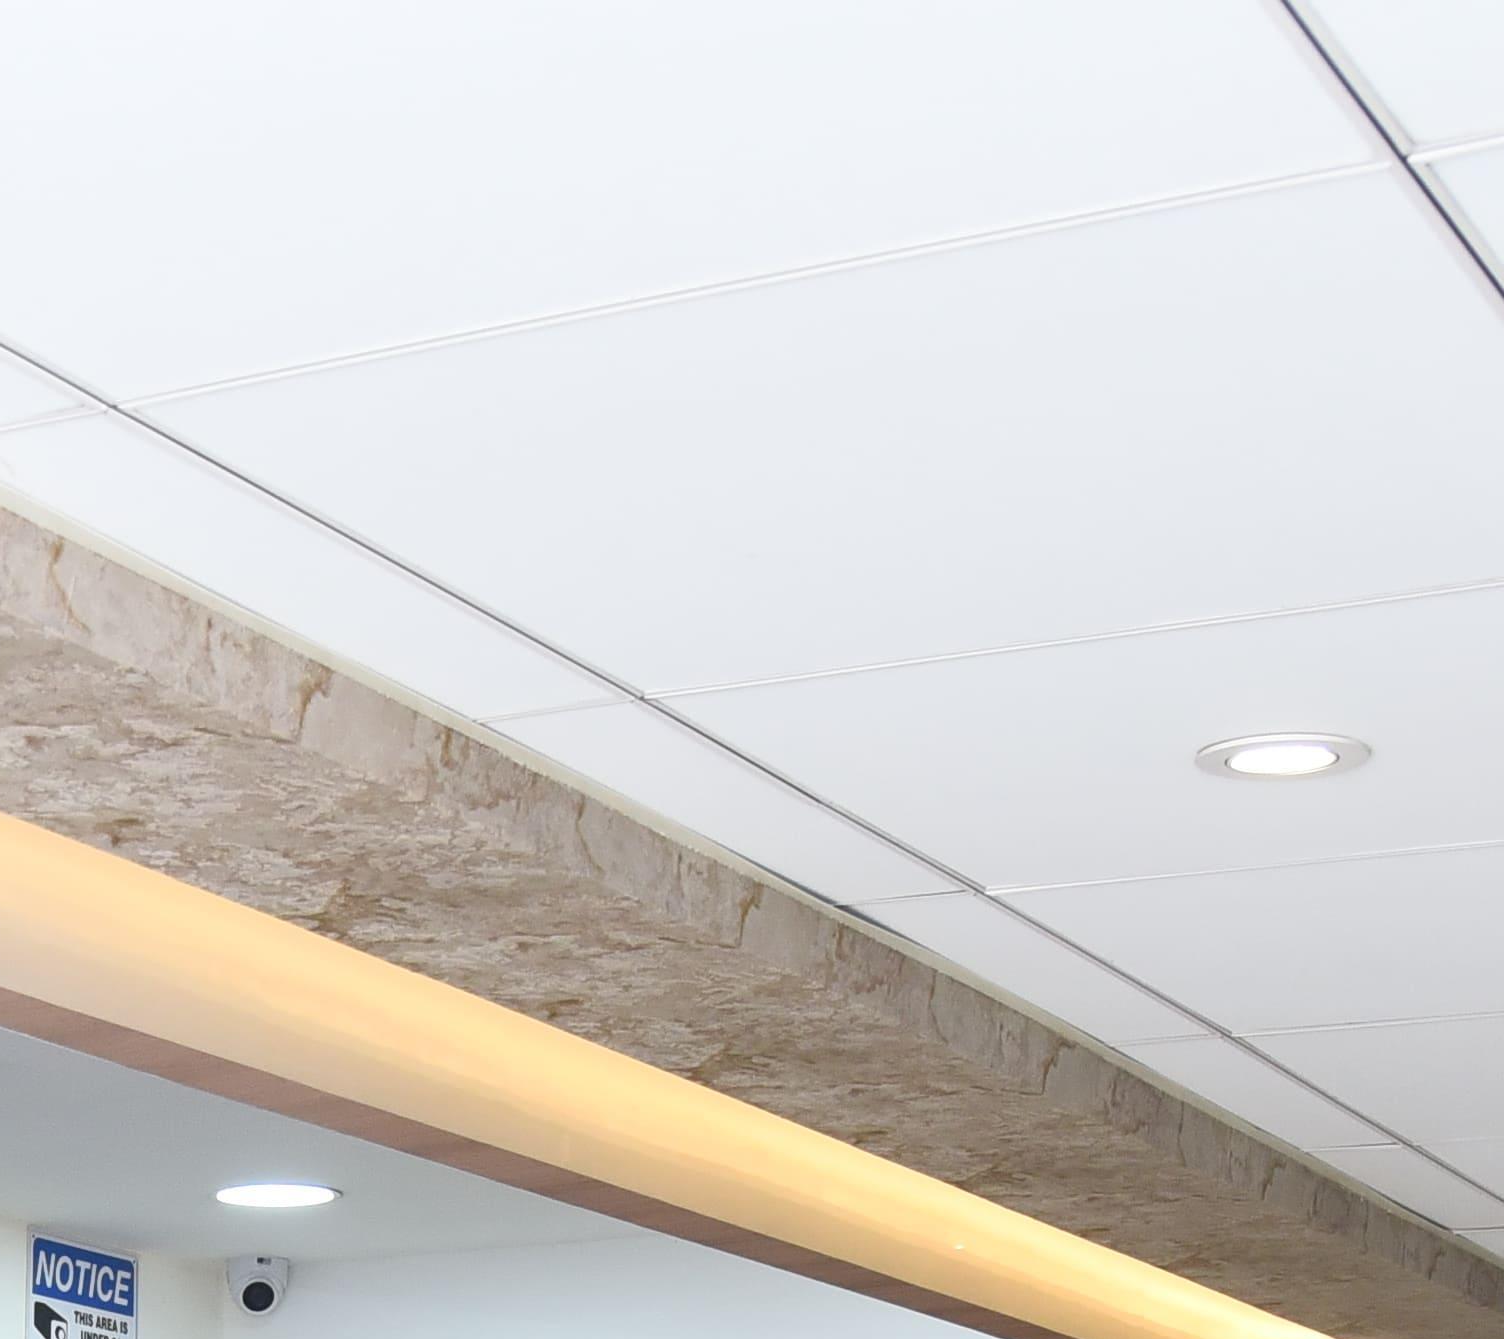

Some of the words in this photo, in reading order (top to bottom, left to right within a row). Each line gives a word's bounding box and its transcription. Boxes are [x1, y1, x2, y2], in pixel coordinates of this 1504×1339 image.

[35, 1250, 132, 1307] NOTICE
[74, 1311, 94, 1327] THIS
[96, 1315, 118, 1333] AREA
[120, 1321, 129, 1335] IS
